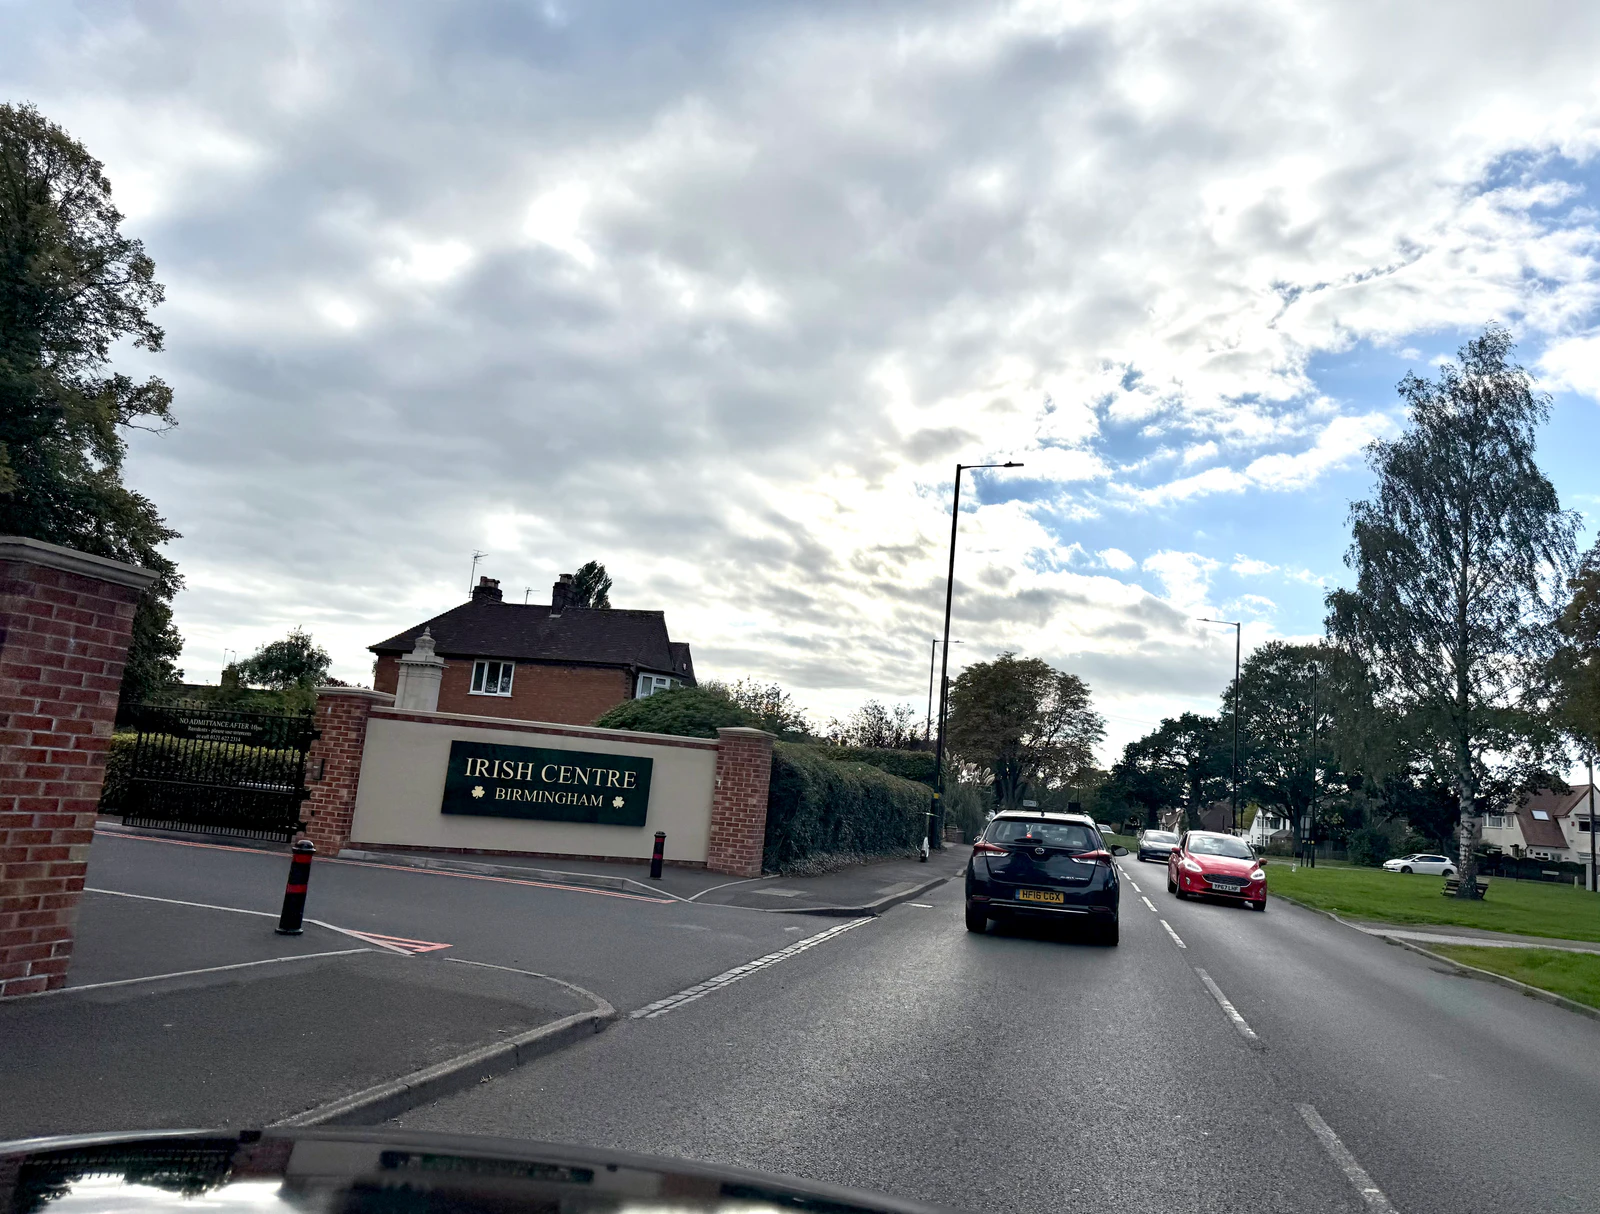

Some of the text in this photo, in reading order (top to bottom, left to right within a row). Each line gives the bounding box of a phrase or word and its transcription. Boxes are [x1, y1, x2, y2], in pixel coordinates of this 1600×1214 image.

[189, 718, 230, 728] ADMITTANCE
[229, 722, 249, 730] AFTER
[464, 757, 637, 789] IRISH CENTRE
[494, 787, 604, 807] BIRMINGHAM
[1022, 890, 1061, 901] HF16 CGX
